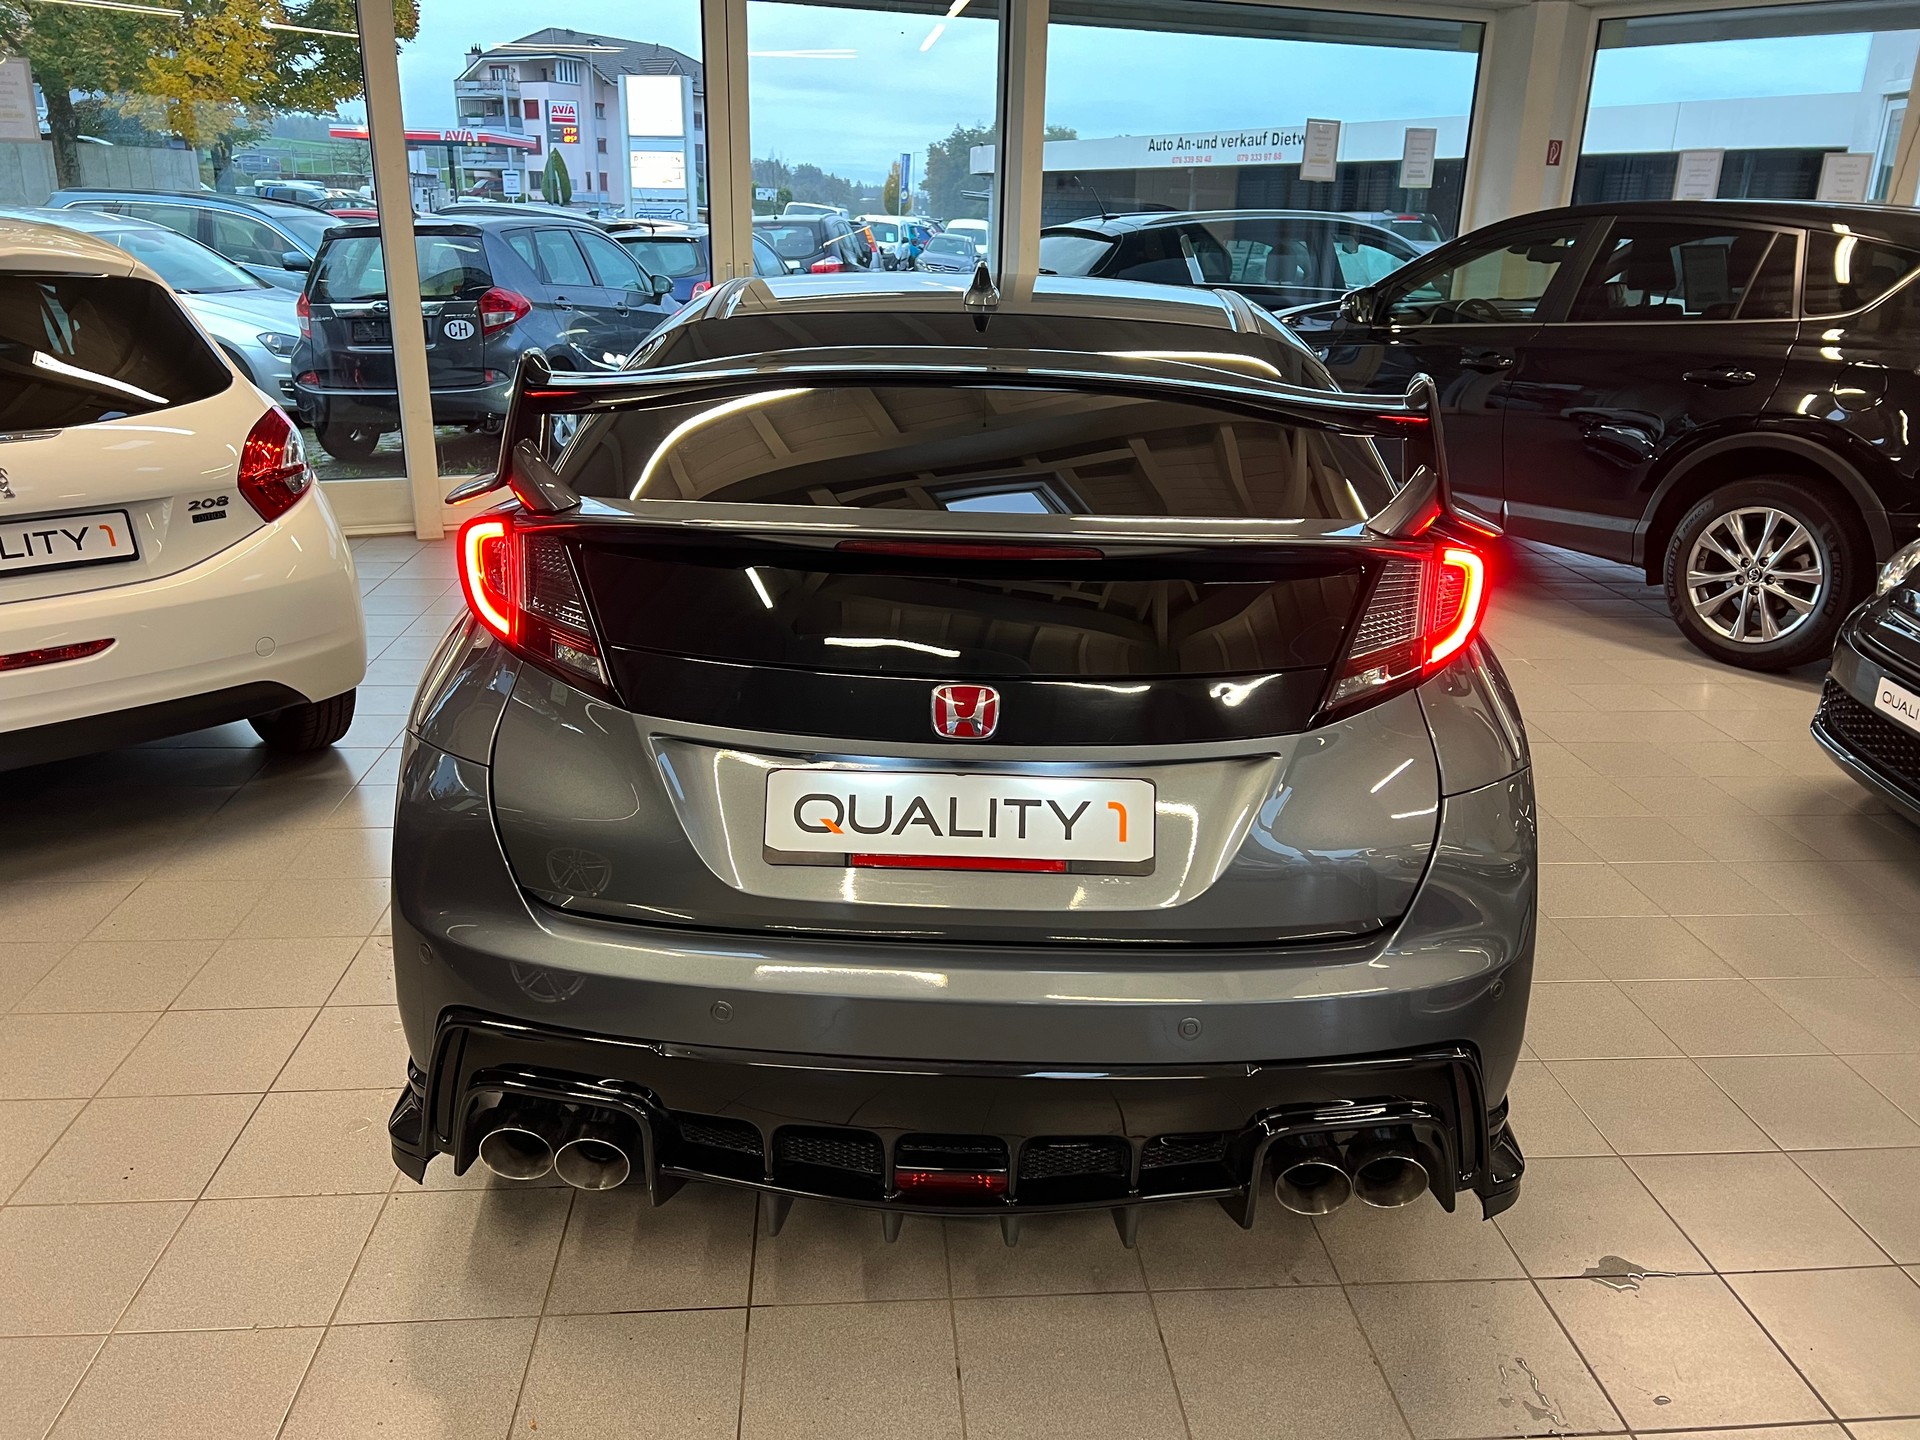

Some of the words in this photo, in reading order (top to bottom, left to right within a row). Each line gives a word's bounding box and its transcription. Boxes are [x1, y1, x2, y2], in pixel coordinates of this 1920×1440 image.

[1148, 138, 1174, 152] Auto
[1221, 131, 1268, 149] verkauf
[449, 320, 468, 337] CH
[188, 495, 229, 511] 208
[193, 511, 226, 522] EDITION
[99, 525, 116, 547] 1
[1882, 691, 1920, 720] QUALI
[793, 793, 1091, 841] QUALITY
[1107, 801, 1127, 842] 1
